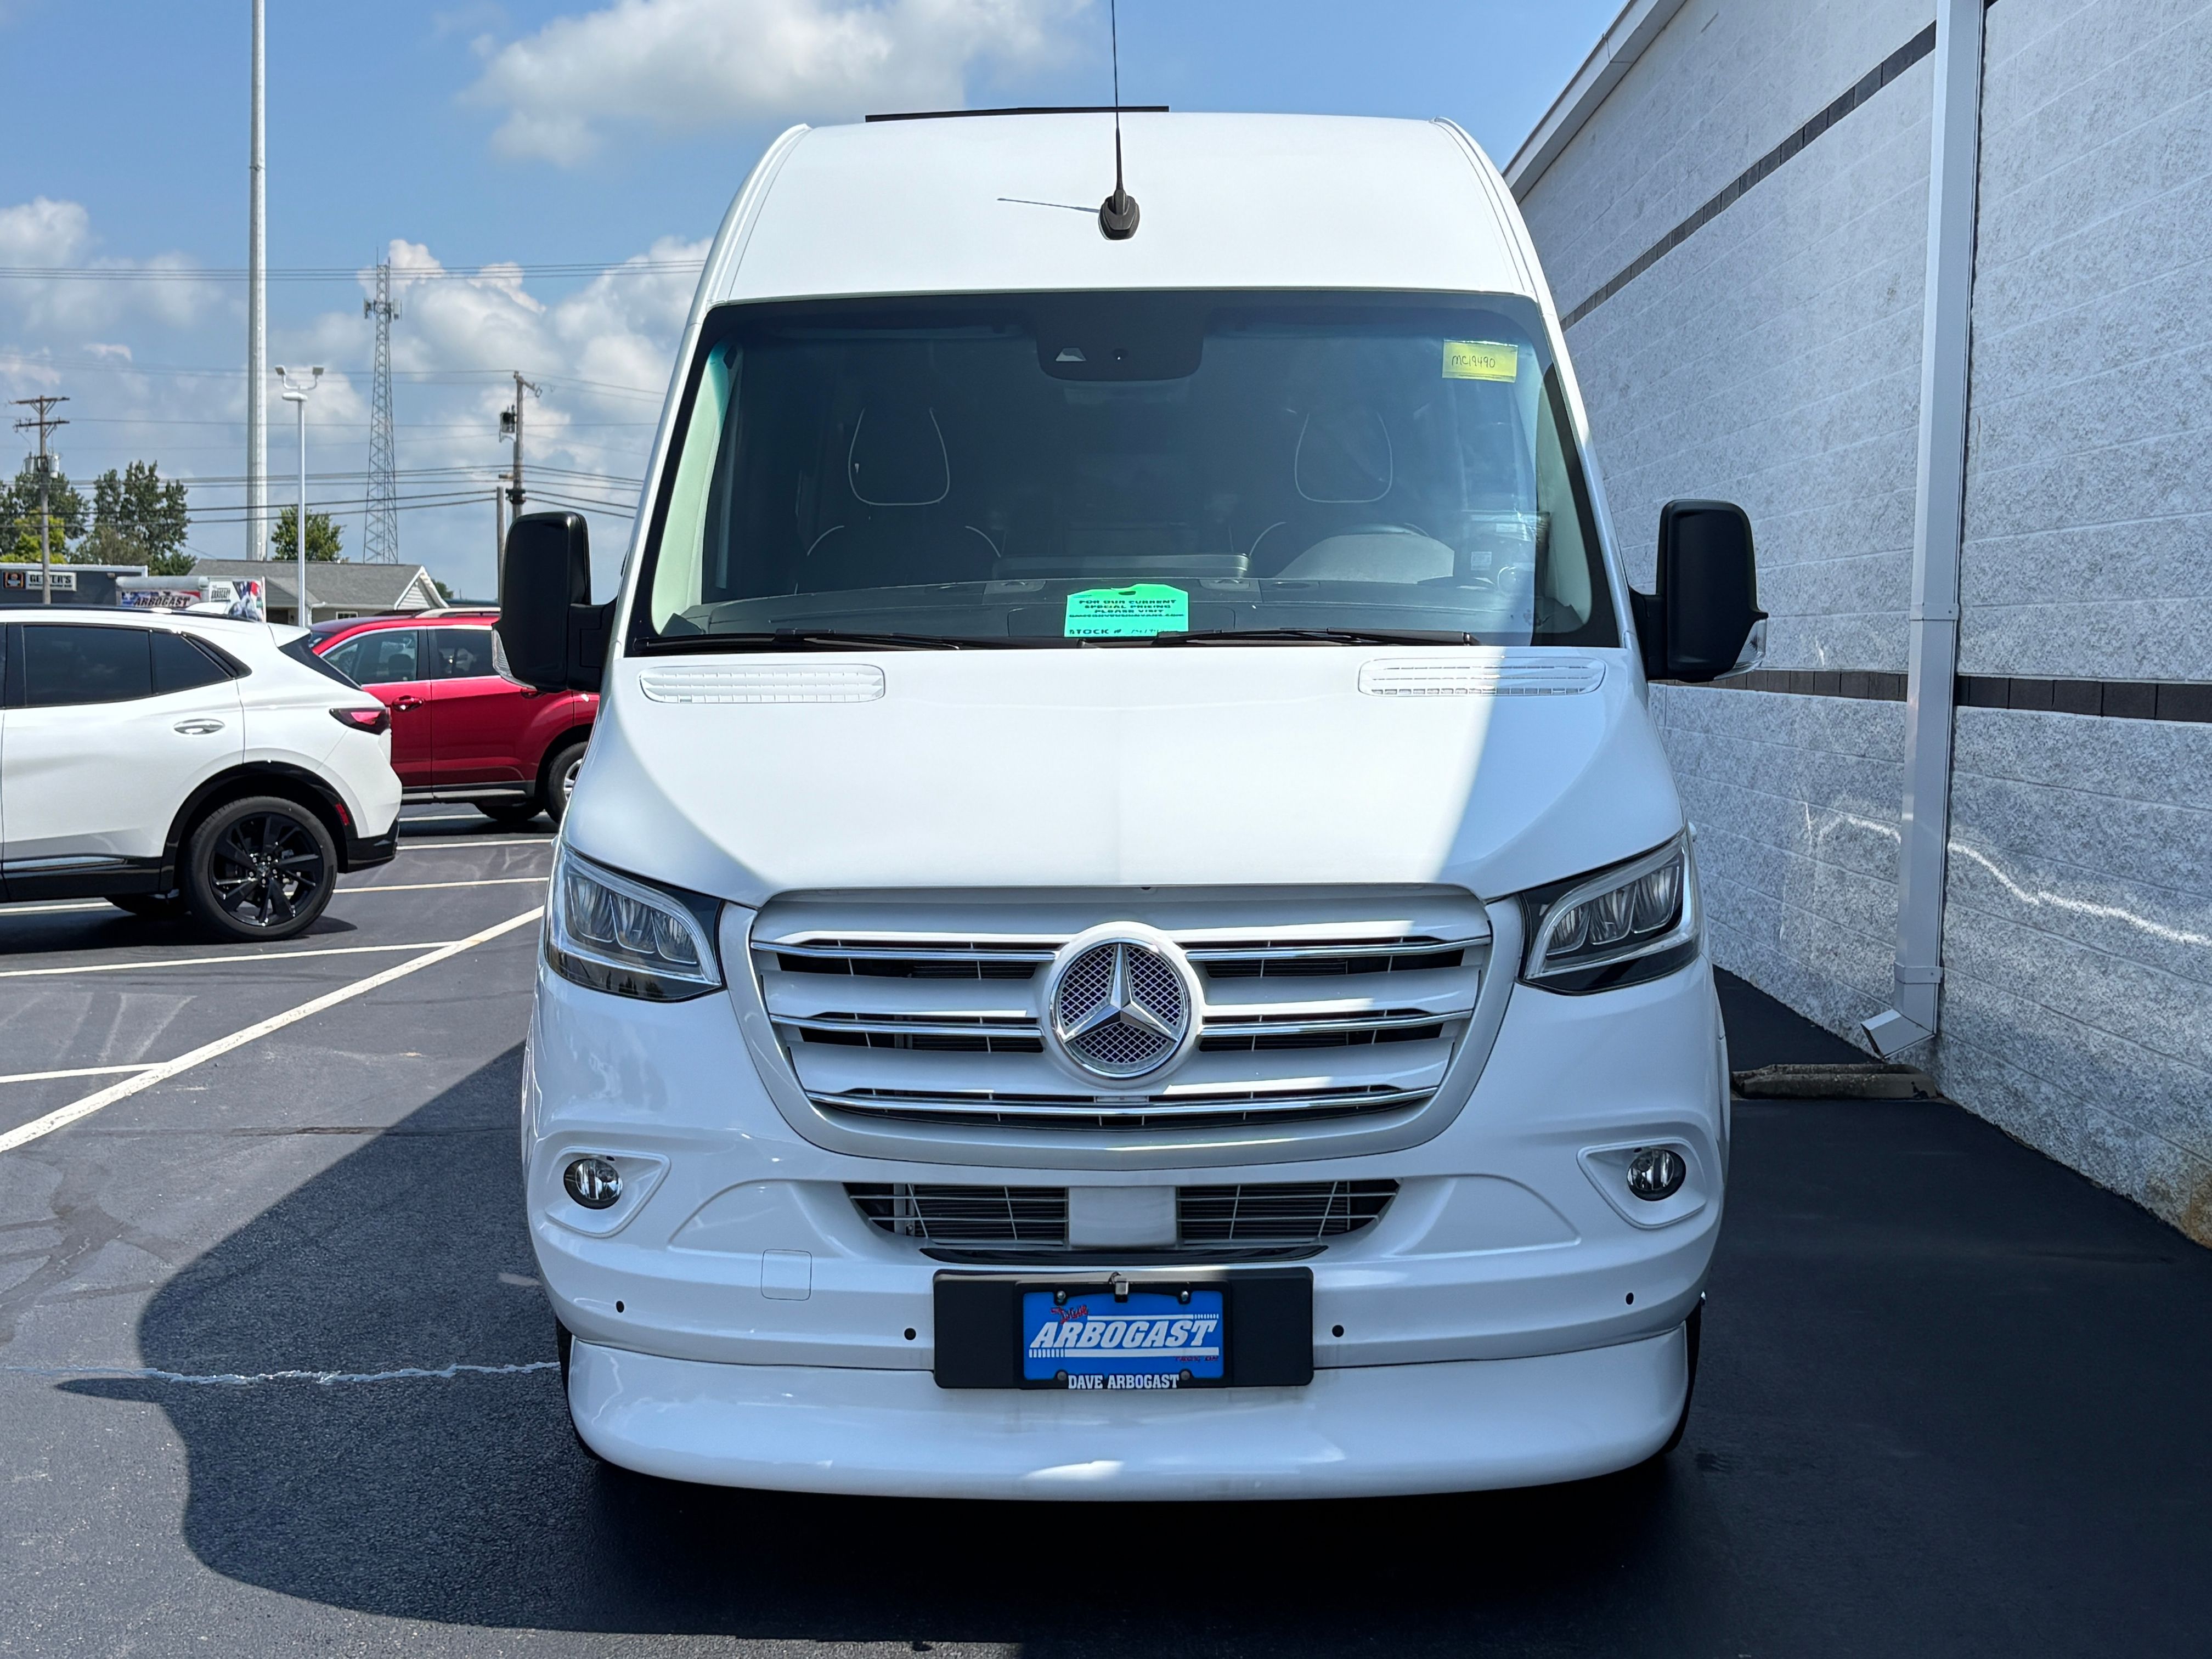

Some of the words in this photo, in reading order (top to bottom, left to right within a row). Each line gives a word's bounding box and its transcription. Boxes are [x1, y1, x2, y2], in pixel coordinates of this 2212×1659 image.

[1452, 355, 1496, 368] MC19490
[1030, 1319, 1218, 1348] ARBOGAST
[1068, 1375, 1103, 1389] DAVE
[1107, 1374, 1180, 1389] ARBOGAST
